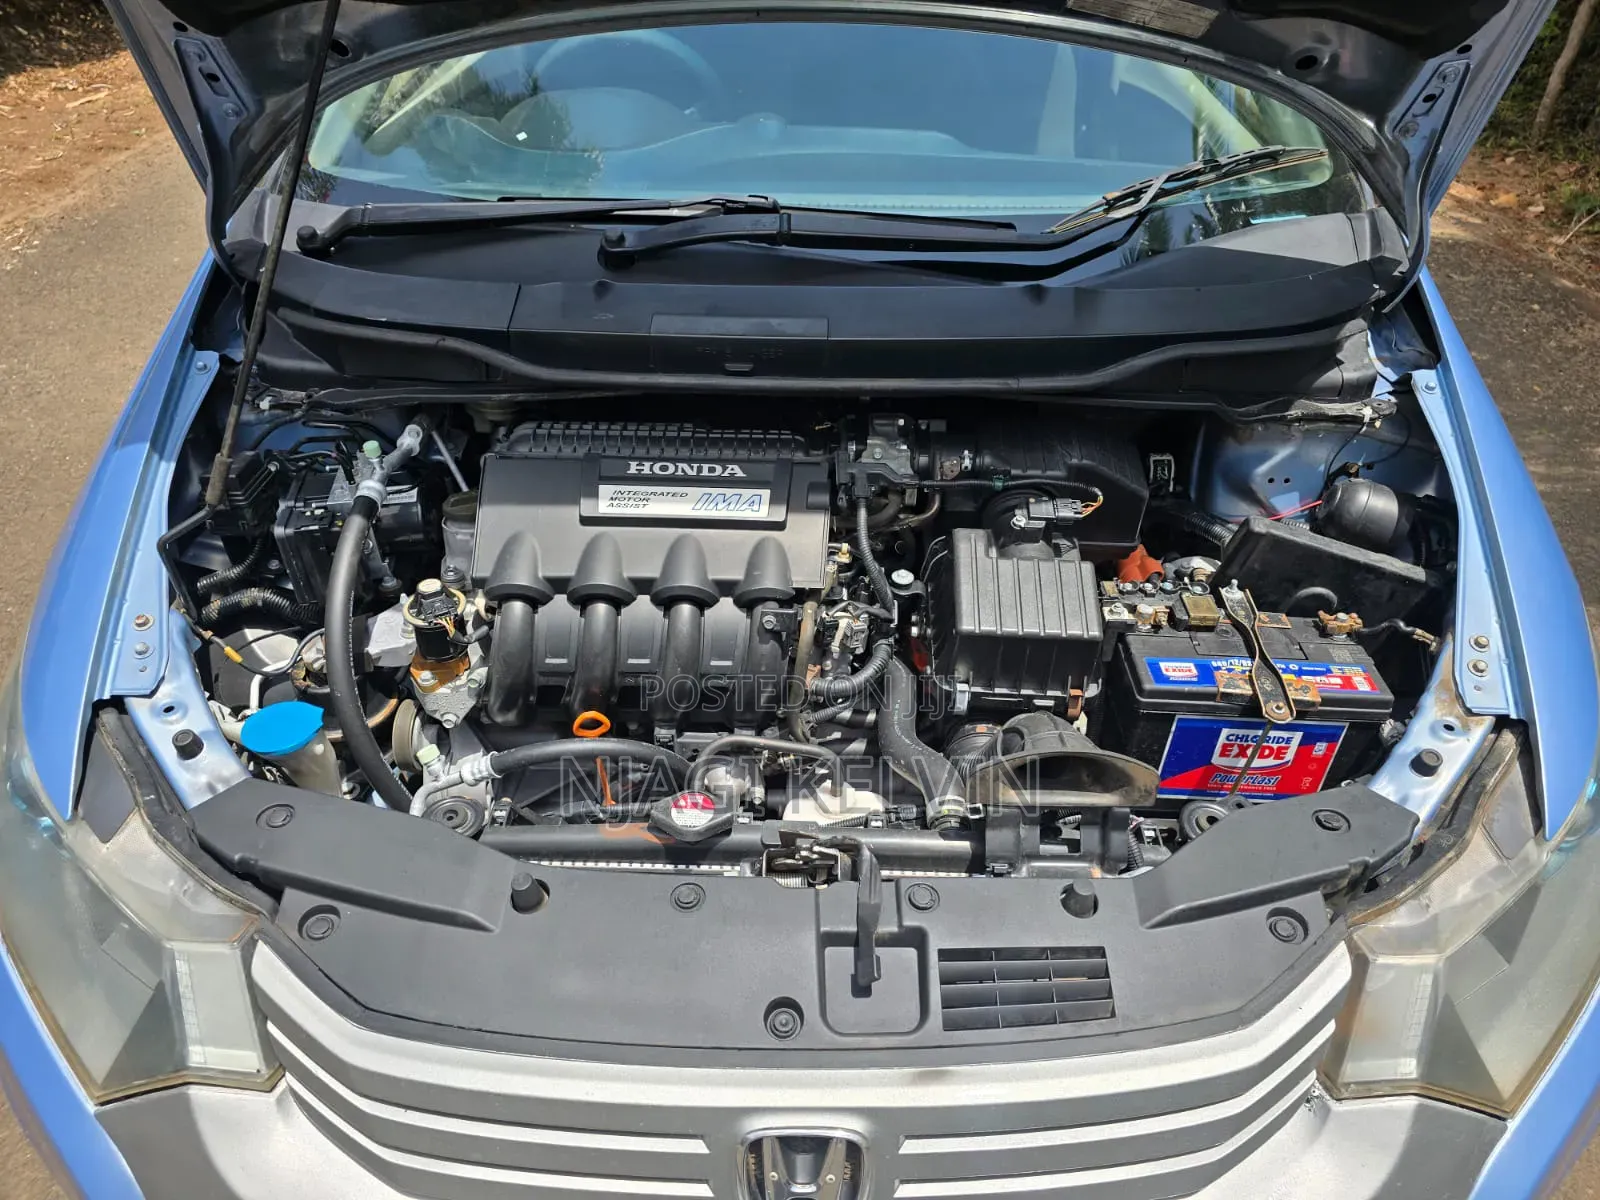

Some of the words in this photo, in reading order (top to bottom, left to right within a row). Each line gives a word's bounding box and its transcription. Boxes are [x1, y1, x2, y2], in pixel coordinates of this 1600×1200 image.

[626, 461, 747, 477] HONDA
[612, 489, 688, 498] INTEGRATED
[692, 492, 763, 513] IMA
[1218, 742, 1291, 760] EXDE
